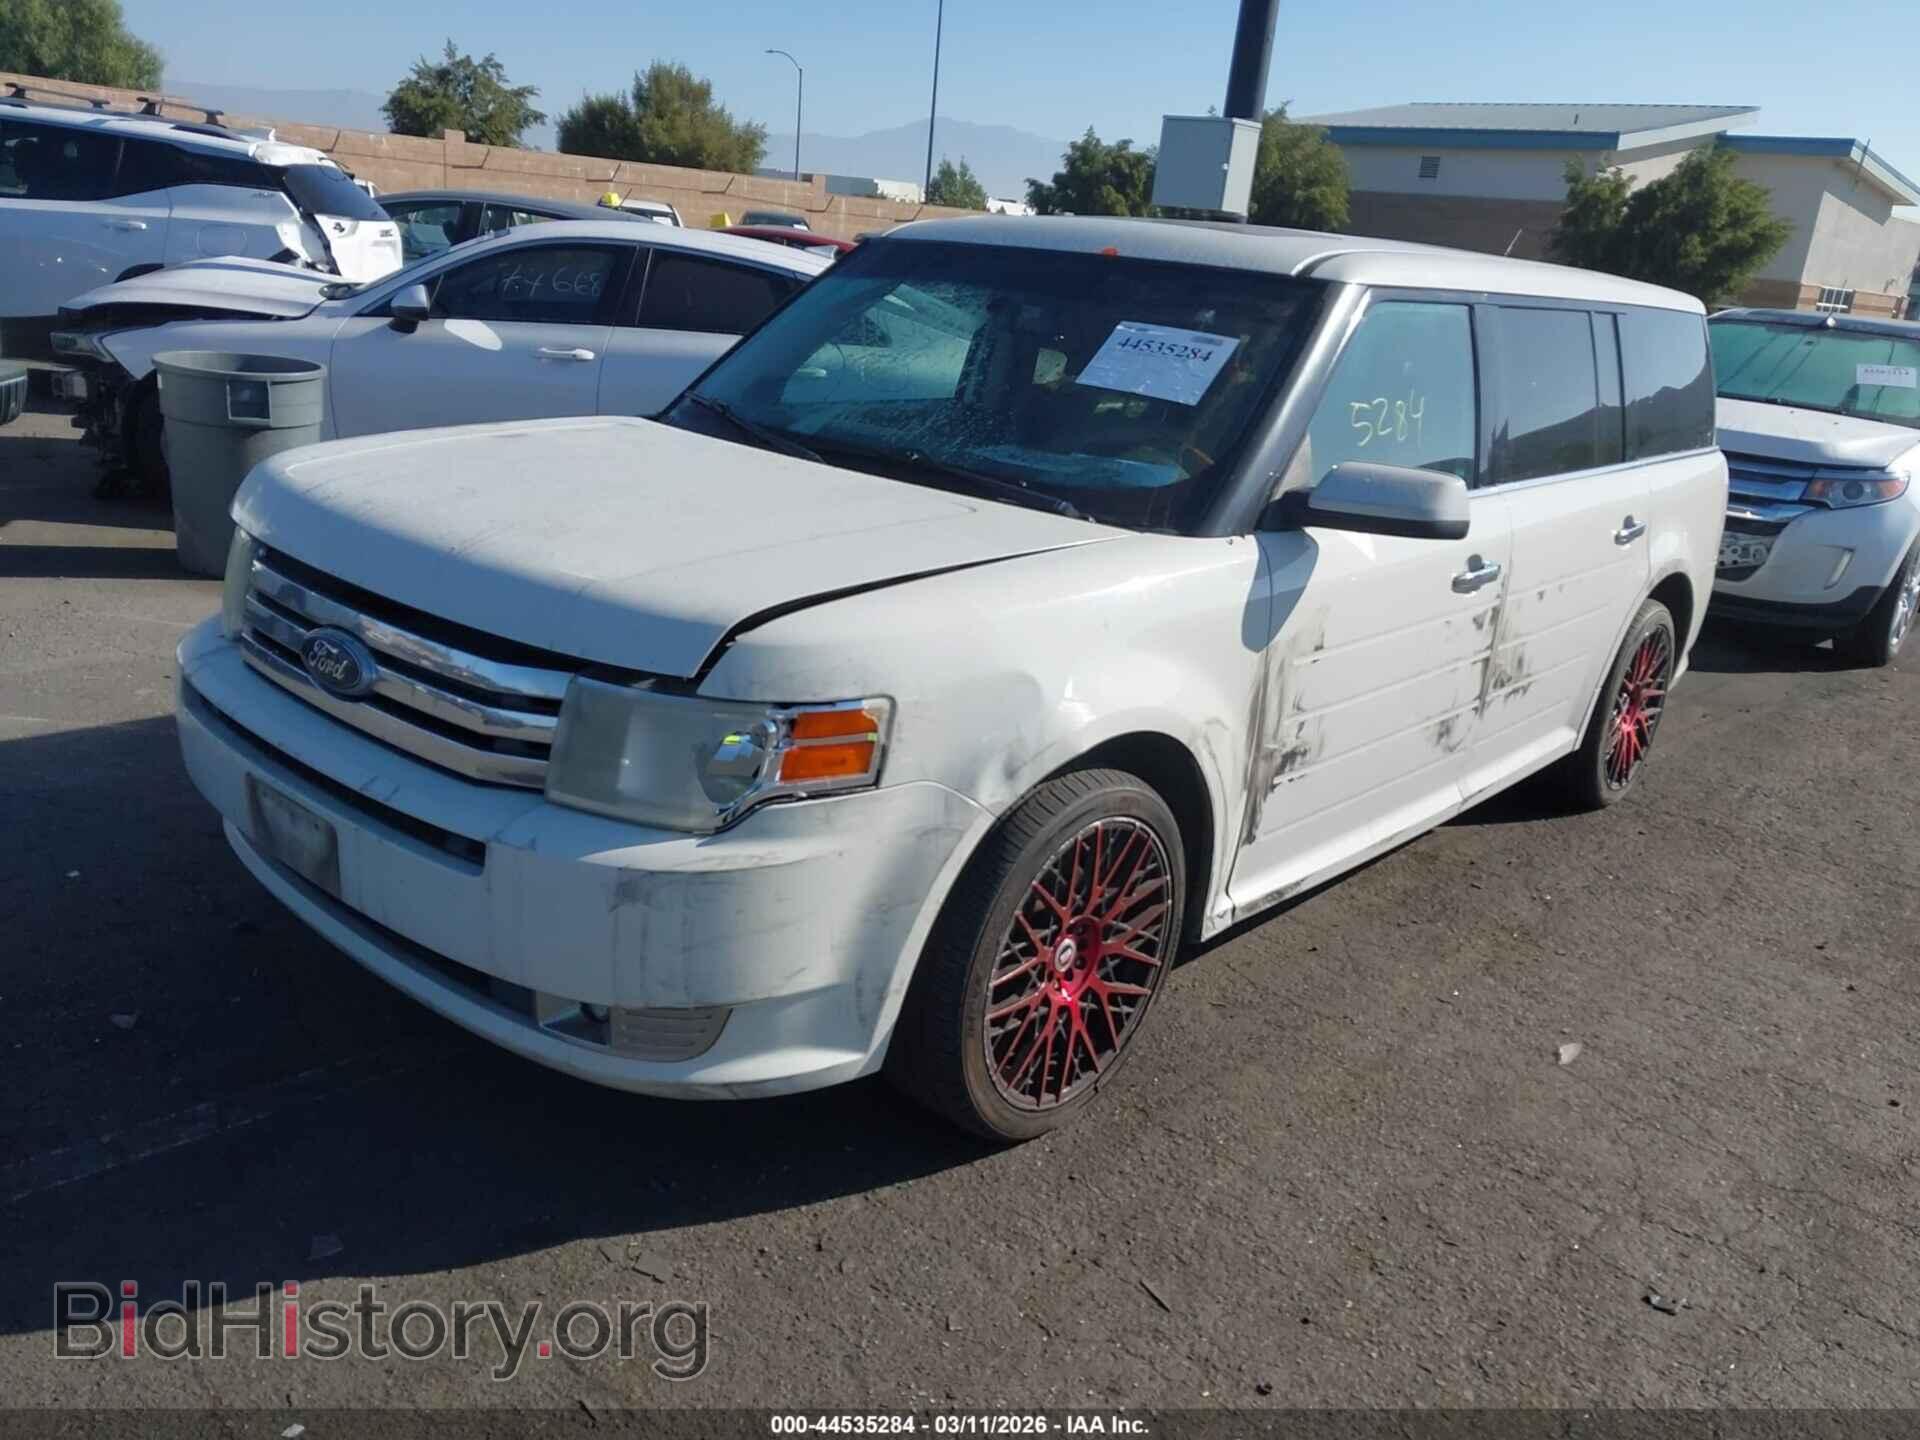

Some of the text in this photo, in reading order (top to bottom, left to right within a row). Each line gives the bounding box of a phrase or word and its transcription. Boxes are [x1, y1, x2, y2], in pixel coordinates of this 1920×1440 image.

[1117, 336, 1213, 362] 44535284
[1350, 390, 1425, 447] 5284
[308, 639, 348, 680] Ford
